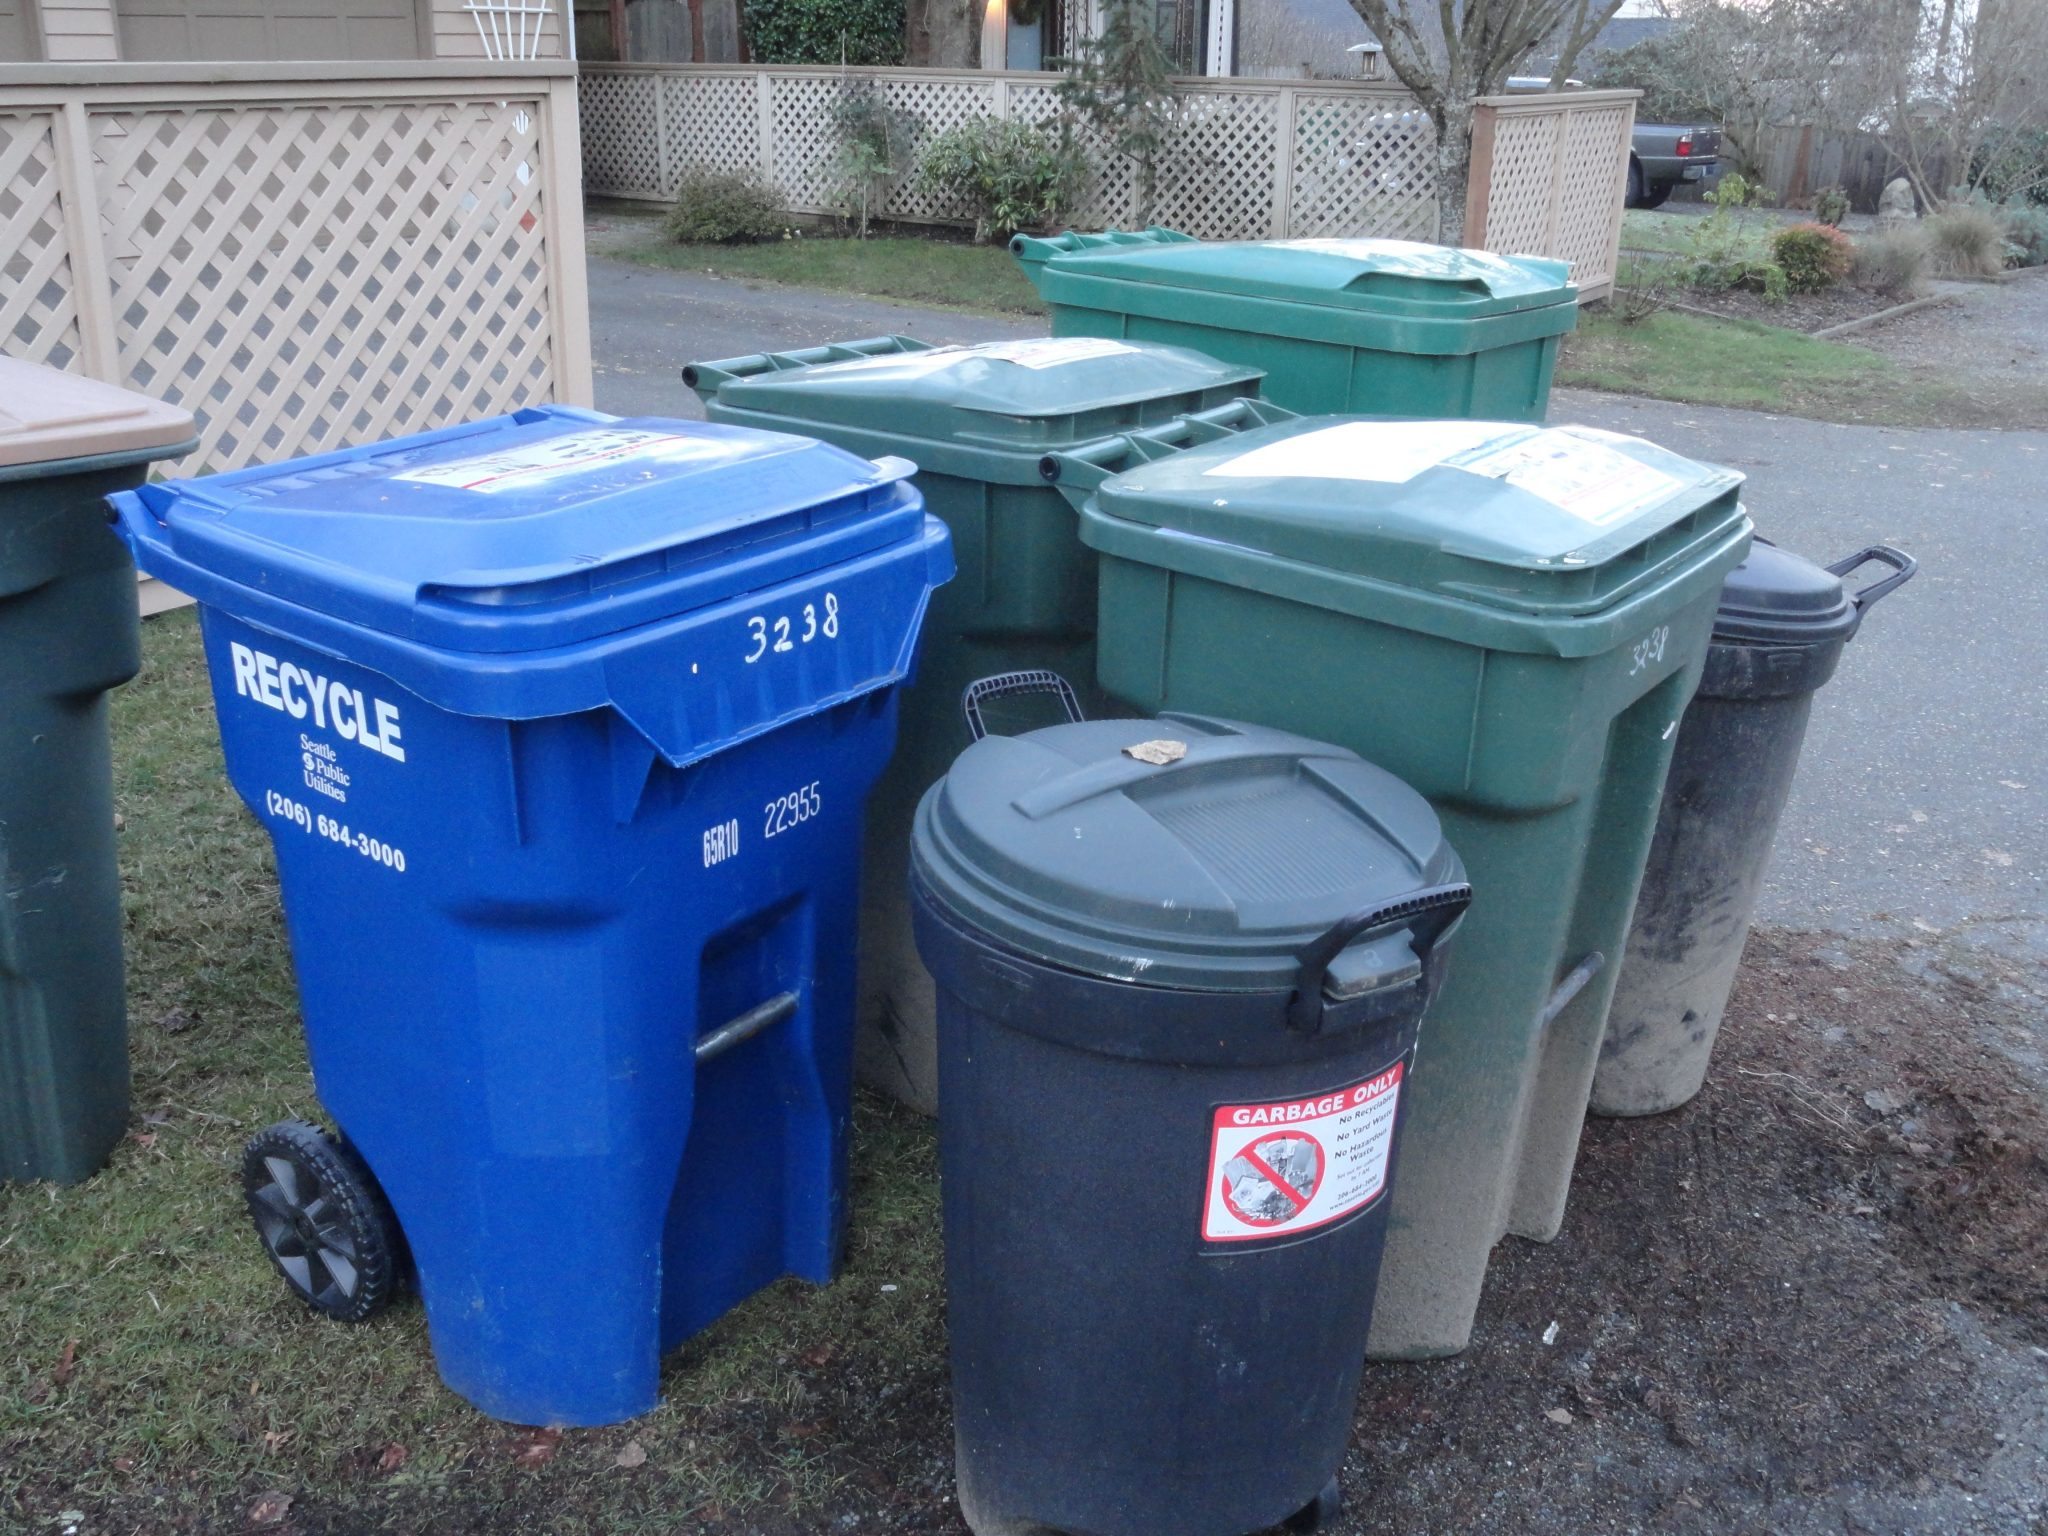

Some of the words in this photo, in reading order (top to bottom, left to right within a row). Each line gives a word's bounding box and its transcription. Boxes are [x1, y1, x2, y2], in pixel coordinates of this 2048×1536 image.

[745, 592, 838, 664] 3238
[1629, 625, 1669, 676] 3238
[230, 641, 405, 762] RECYCLE
[300, 733, 337, 762] Seattle
[303, 770, 346, 802] Utilities
[316, 760, 350, 787] Public
[266, 789, 311, 833] (206)
[317, 814, 406, 872] 684-3000
[703, 818, 738, 868] 65R10
[764, 780, 820, 839] 22955
[1232, 1094, 1344, 1125] GARBAGE
[1353, 1069, 1396, 1103] ONLY
[1339, 1116, 1352, 1125] No
[1354, 1092, 1395, 1119] Recyclables
[1337, 1133, 1350, 1142] No
[1352, 1122, 1371, 1136] Yard
[1372, 1108, 1393, 1126] Waste
[1334, 1150, 1347, 1159] No
[1350, 1128, 1387, 1153] Hazardous
[1350, 1146, 1374, 1163] Waste
